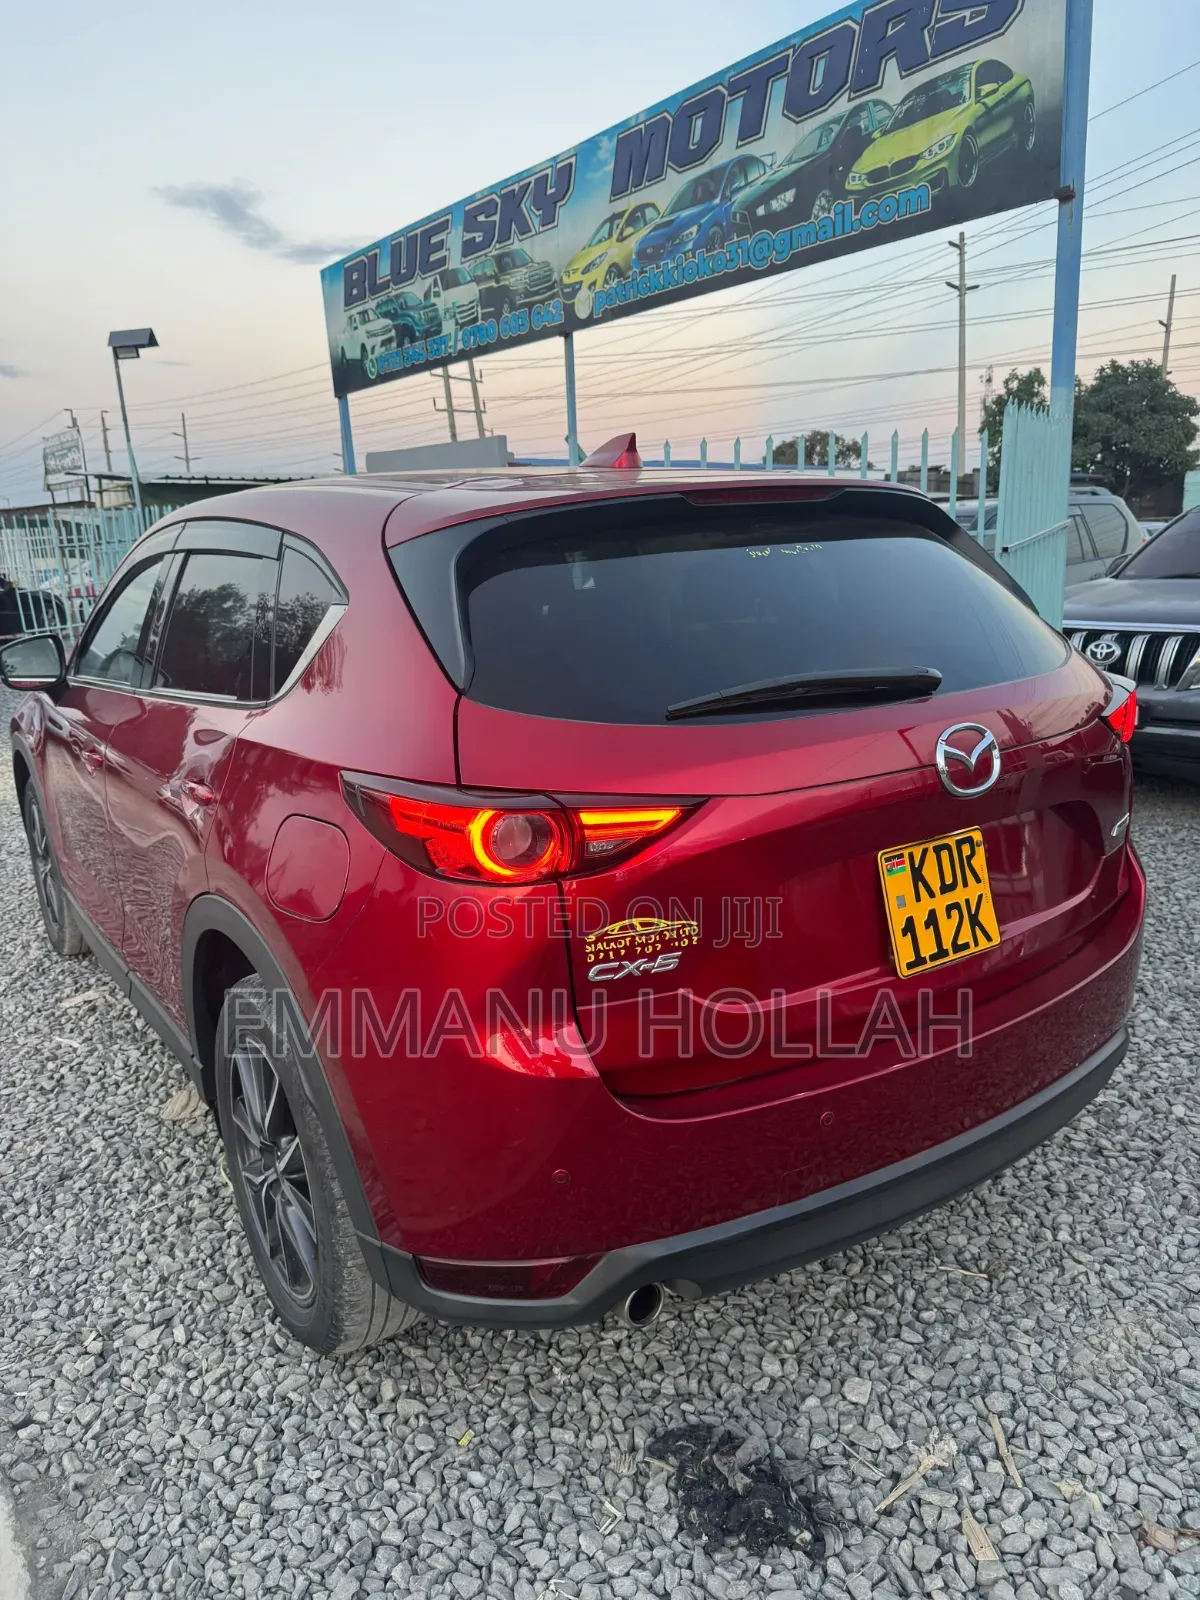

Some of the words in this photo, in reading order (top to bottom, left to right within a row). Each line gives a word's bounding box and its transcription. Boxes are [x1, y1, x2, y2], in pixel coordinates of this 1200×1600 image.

[344, 213, 452, 312] BLUE
[461, 154, 577, 263] SKY
[609, 0, 1025, 202] MOTORS
[593, 182, 932, 318] patrickkioko31@gmail.com
[461, 318, 498, 351] 0780
[500, 308, 529, 340] 603
[531, 298, 564, 331] 642
[907, 835, 982, 903] KDR
[587, 952, 682, 982] CX-5
[900, 893, 993, 971] 112K
